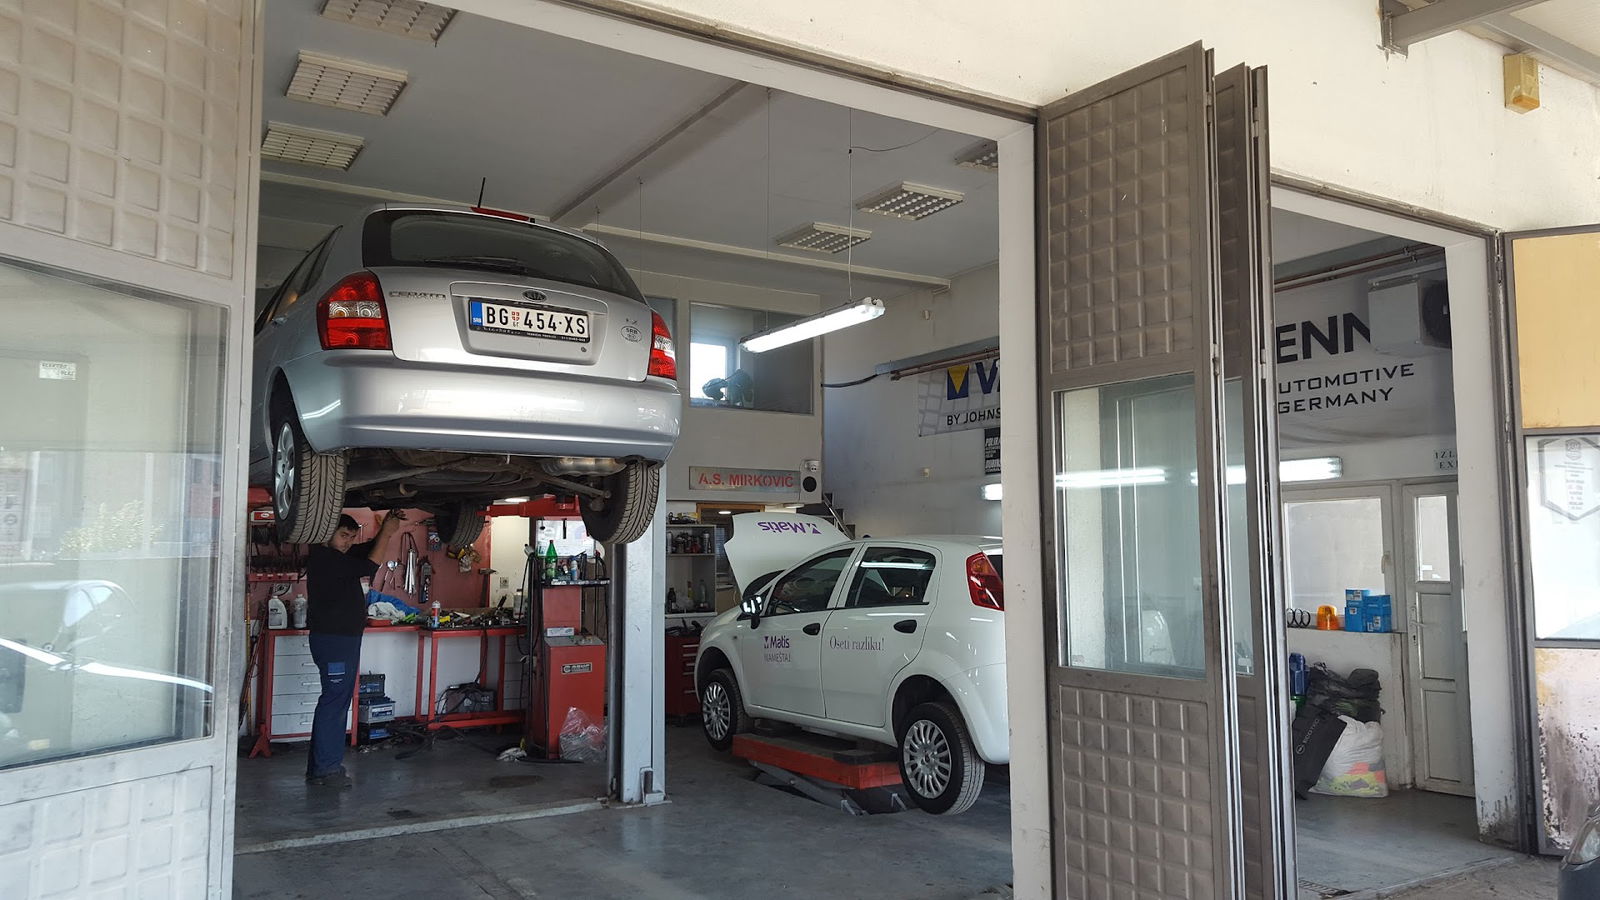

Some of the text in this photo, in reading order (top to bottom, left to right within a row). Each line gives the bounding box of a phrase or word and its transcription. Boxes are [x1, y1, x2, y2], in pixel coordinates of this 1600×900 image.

[486, 306, 508, 326] BG
[1278, 387, 1394, 414] GERMANY
[947, 414, 961, 426] BY
[699, 473, 794, 488] A.S. MIRKOVIĆ
[757, 521, 806, 533] Matis
[770, 635, 790, 649] Matis
